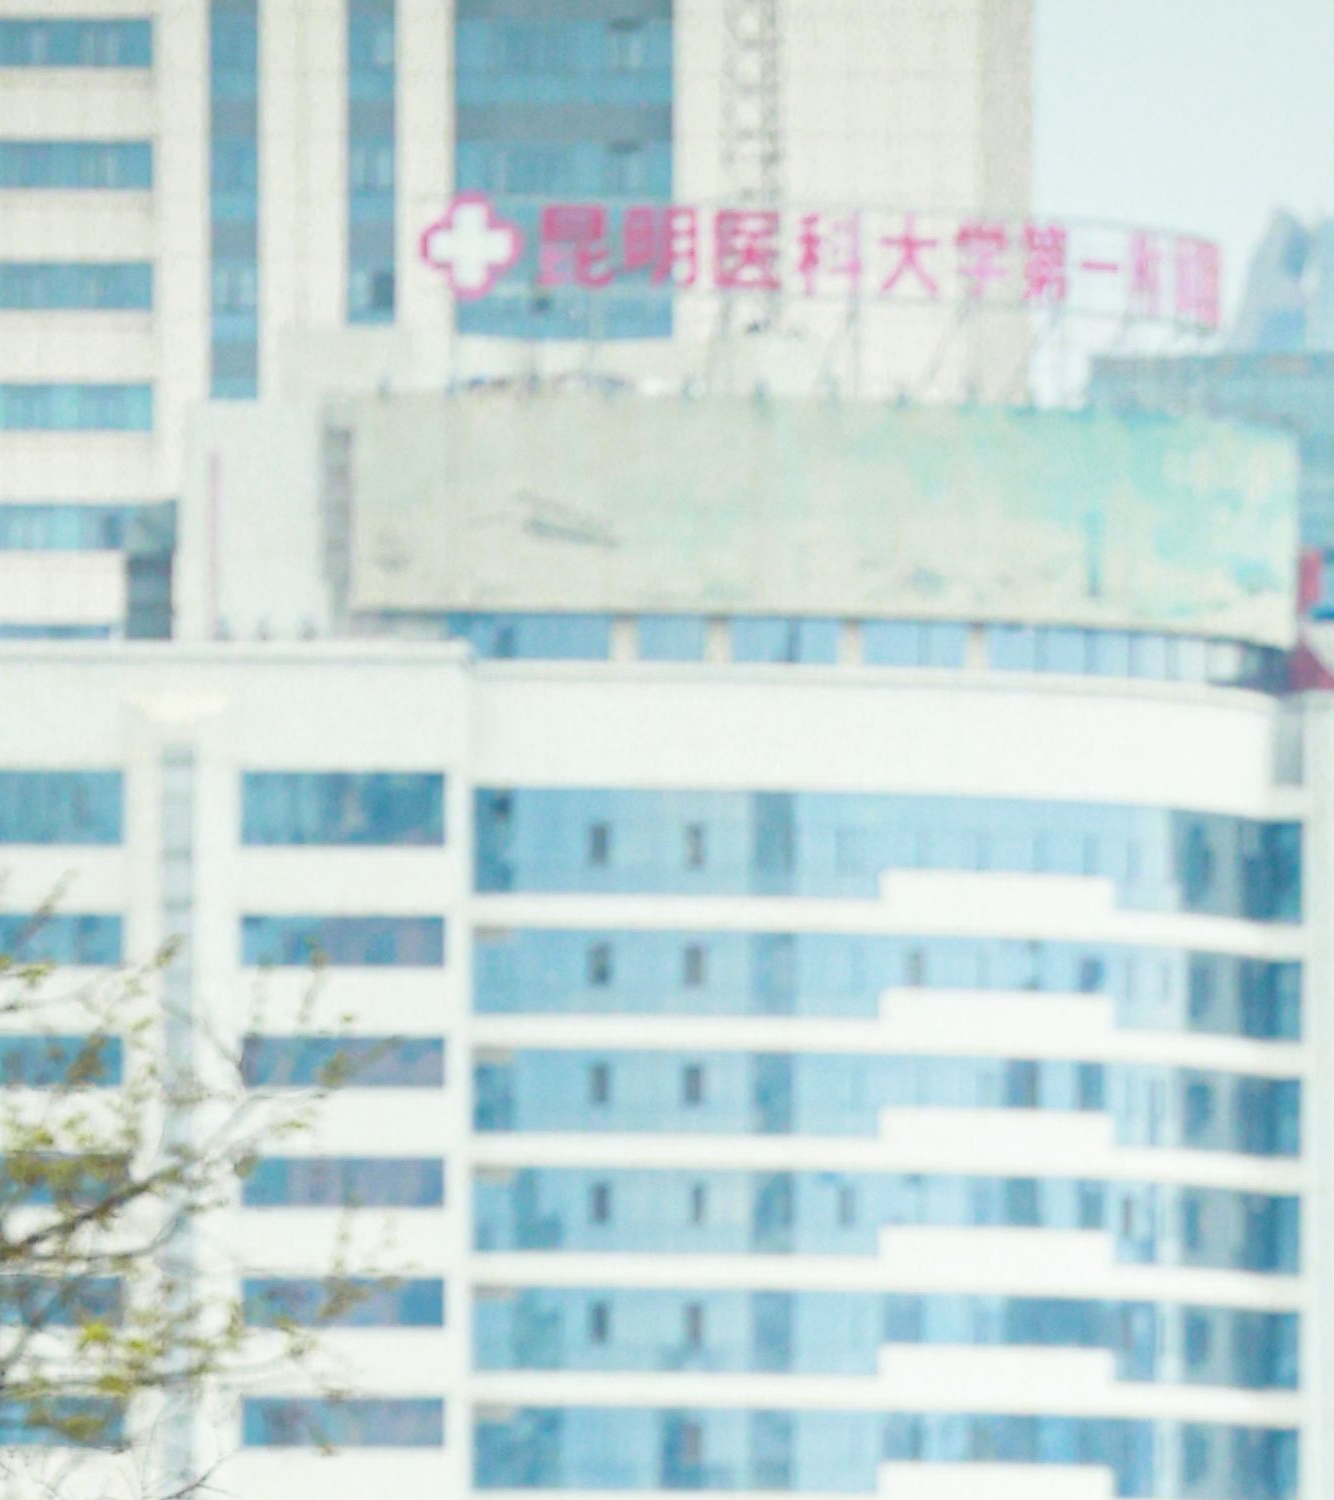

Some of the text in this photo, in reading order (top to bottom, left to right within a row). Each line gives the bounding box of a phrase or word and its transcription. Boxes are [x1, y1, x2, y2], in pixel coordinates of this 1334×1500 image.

[535, 202, 1222, 332] 昆明医科大学第一
